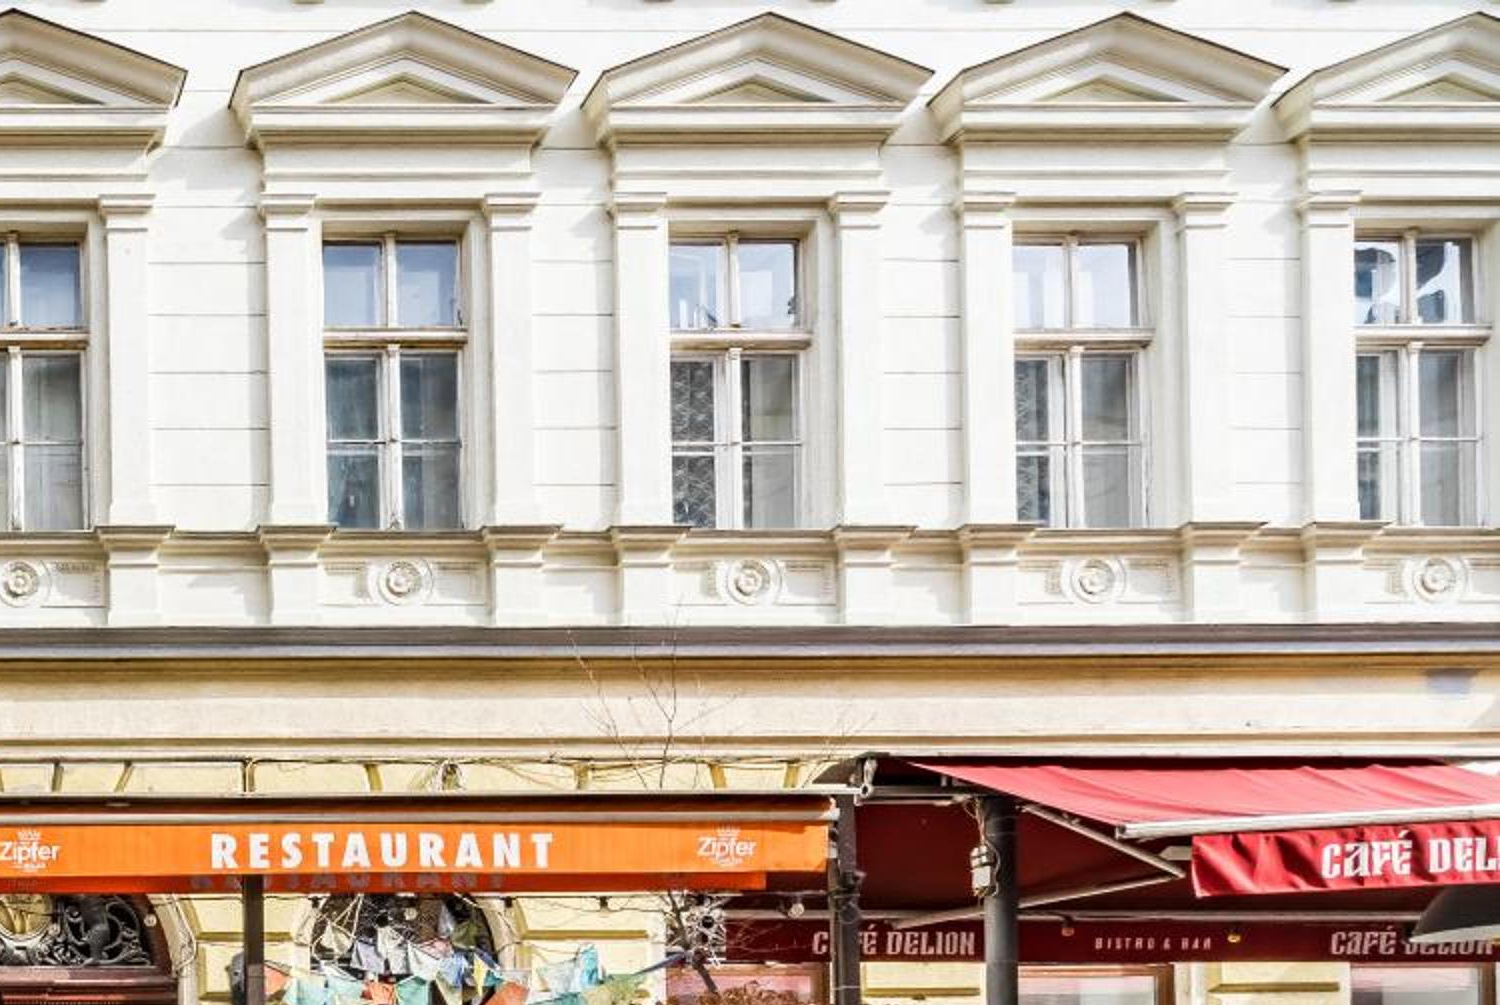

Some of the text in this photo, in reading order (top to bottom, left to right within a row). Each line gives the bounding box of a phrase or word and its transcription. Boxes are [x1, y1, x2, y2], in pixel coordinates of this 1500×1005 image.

[211, 832, 555, 870] RESTAURANT
[696, 837, 757, 861] Zipfer
[1321, 830, 1413, 879] CAFÉ
[886, 931, 975, 956] DELION
[1330, 925, 1397, 955] CAFÉ
